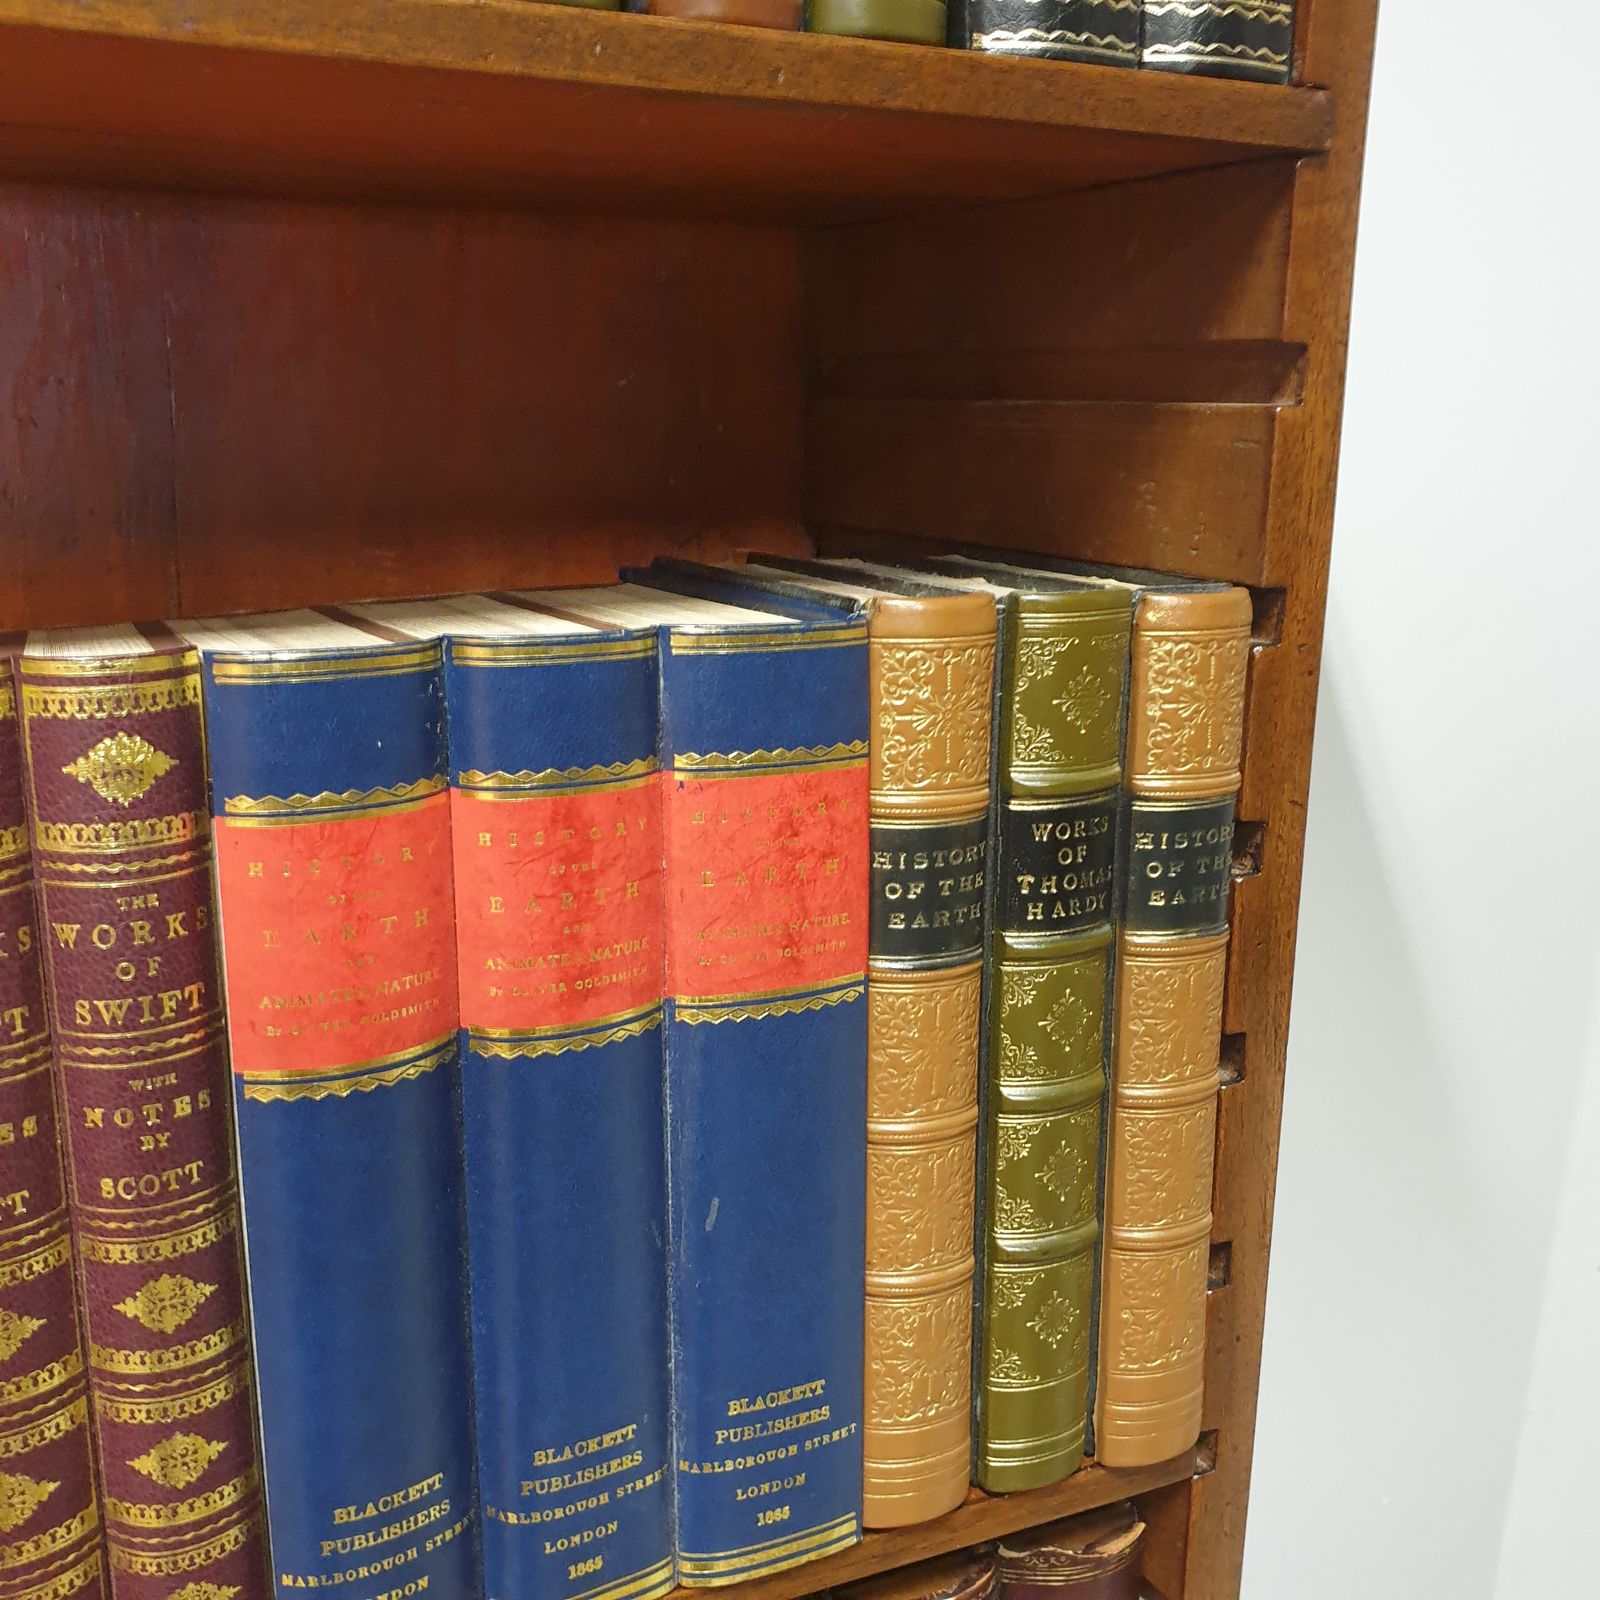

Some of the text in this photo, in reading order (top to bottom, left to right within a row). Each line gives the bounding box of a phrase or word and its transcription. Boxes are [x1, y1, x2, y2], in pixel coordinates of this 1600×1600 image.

[478, 818, 647, 847] HISTORY
[1032, 816, 1108, 842] WORKS
[873, 840, 986, 870] HISTORY
[1058, 845, 1087, 865] OF
[1147, 861, 1184, 878] OF
[117, 893, 160, 911] THE
[490, 880, 640, 913] EARTH
[885, 872, 984, 900] OF THE
[888, 902, 981, 929] EARTH
[1027, 892, 1107, 920] HARDY
[52, 906, 208, 950] WORKS
[263, 908, 429, 948] EARTH
[589, 937, 648, 962] NATURE
[115, 956, 161, 982] OF
[74, 982, 205, 1026] SWIFT
[129, 1072, 178, 1091] WITH
[84, 1088, 212, 1129] NOTES
[140, 1132, 170, 1151] BY
[101, 1160, 204, 1200] SCOTT
[727, 1379, 826, 1416] BLACKETT
[716, 1405, 830, 1445] PUBLISHERS
[533, 1424, 637, 1466] BLACKETT
[679, 1422, 857, 1474] MARLBOROUGH STREET
[520, 1450, 643, 1496] PUBLISHERS
[736, 1472, 806, 1500] LONDON
[333, 1472, 444, 1525] BLACKETT
[487, 1492, 609, 1524] MARLBOROUGH
[320, 1499, 451, 1557] PUBLISHERS
[544, 1521, 618, 1554] LONDON
[281, 1547, 418, 1588] MARLBOROUGH
